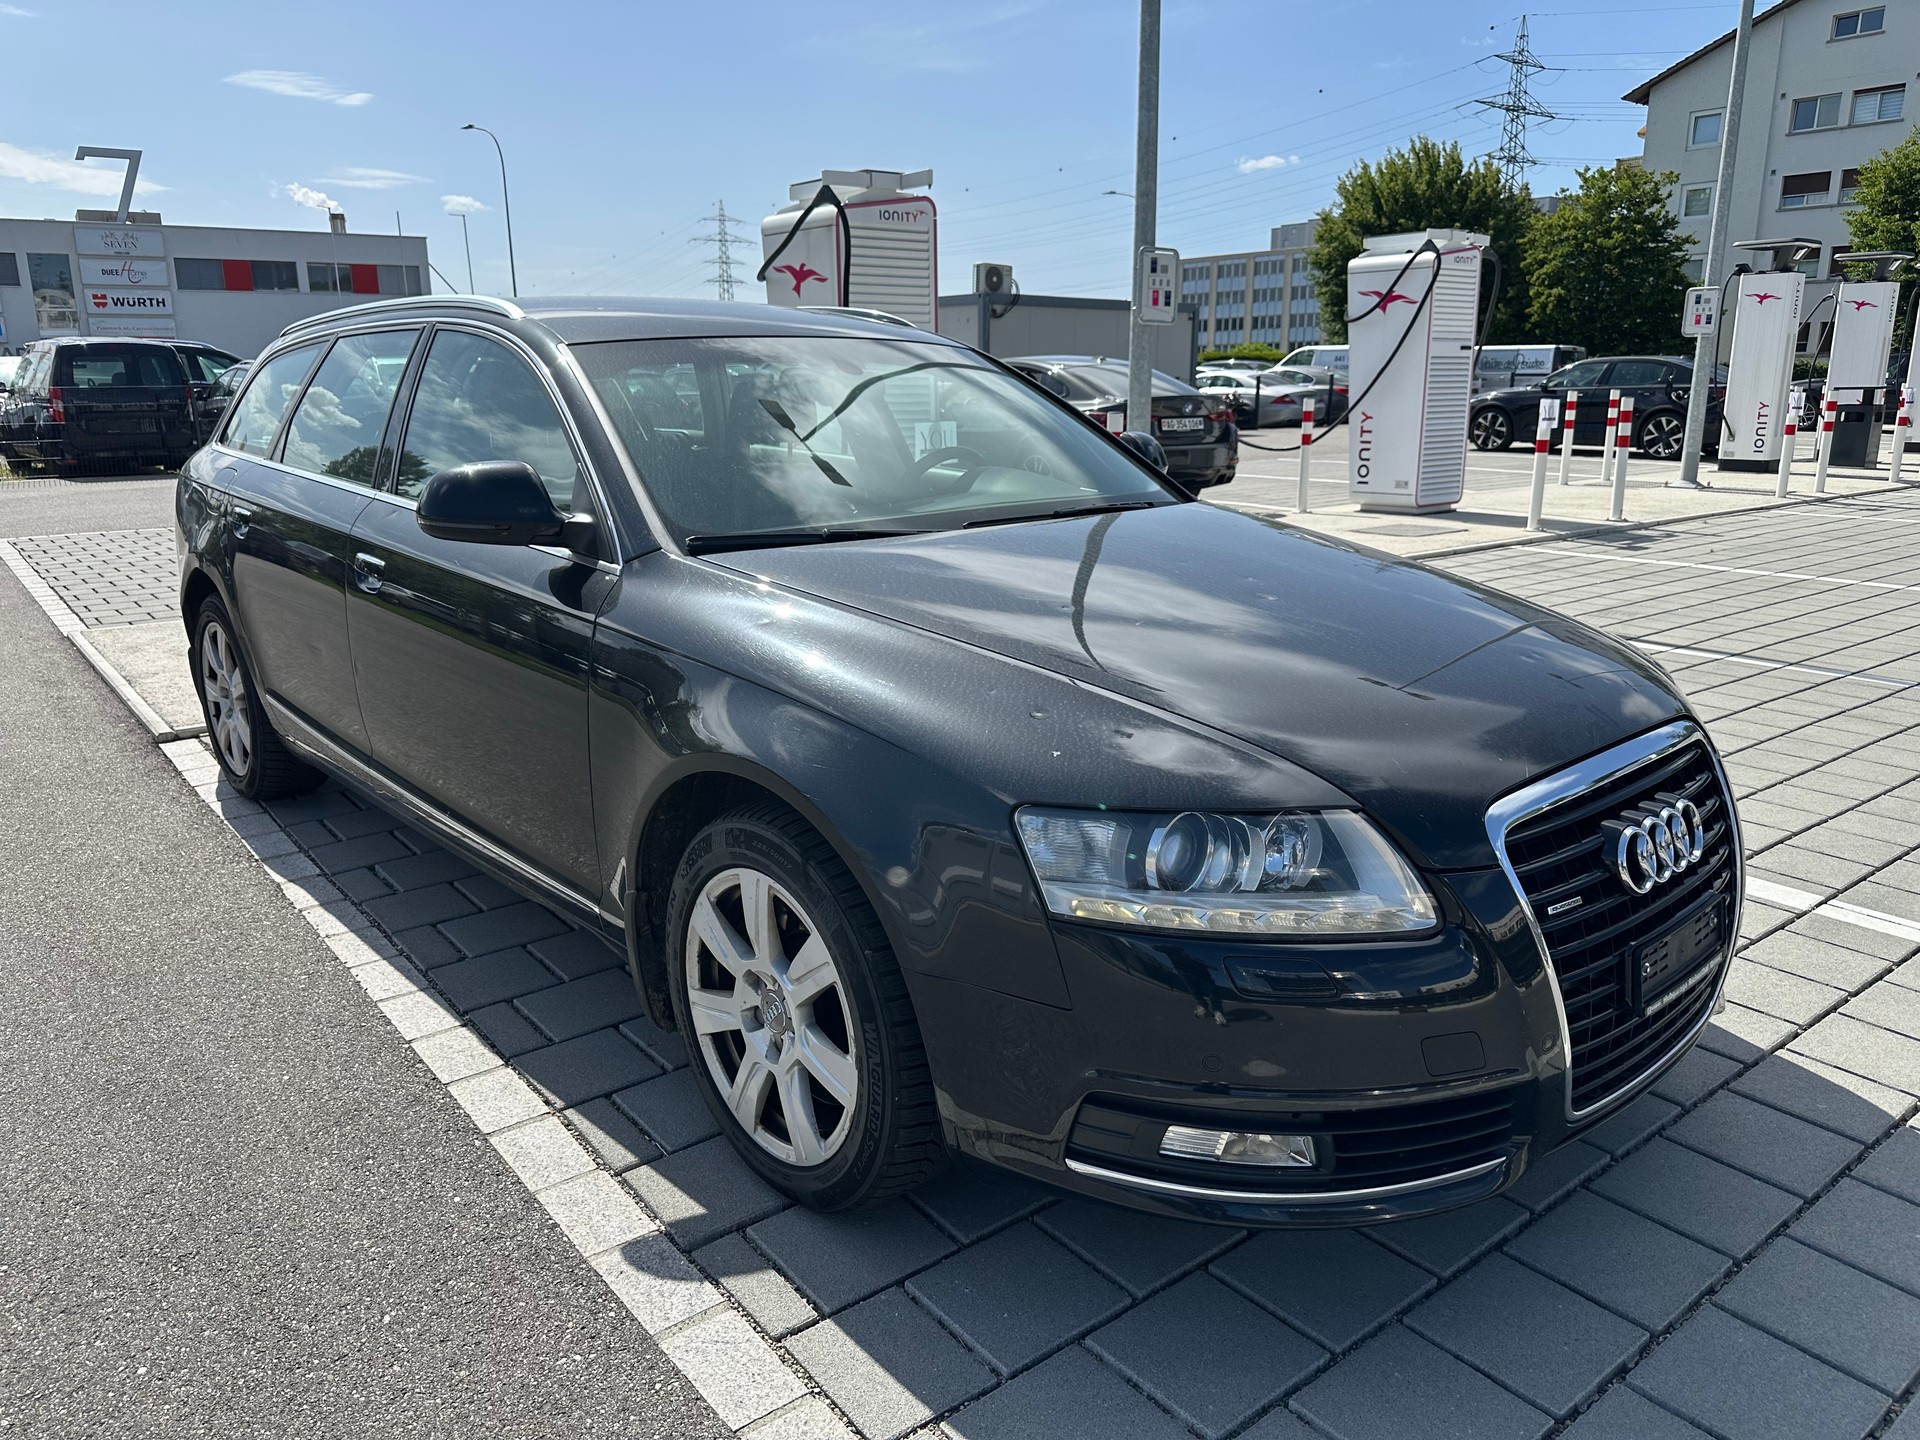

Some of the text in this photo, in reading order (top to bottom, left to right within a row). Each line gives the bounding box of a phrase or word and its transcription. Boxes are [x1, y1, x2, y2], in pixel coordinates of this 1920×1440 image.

[879, 209, 919, 222] IONITY
[103, 241, 138, 249] SEVEN
[1453, 255, 1474, 265] IONITY
[110, 296, 167, 308] WÜRTH
[1792, 280, 1801, 319] IONITY
[1888, 288, 1897, 323] IONITY
[1753, 401, 1770, 453] IONITY
[1357, 411, 1374, 485] IONITY
[863, 1021, 884, 1138] WINGUARD
[858, 1132, 875, 1172] Sport
